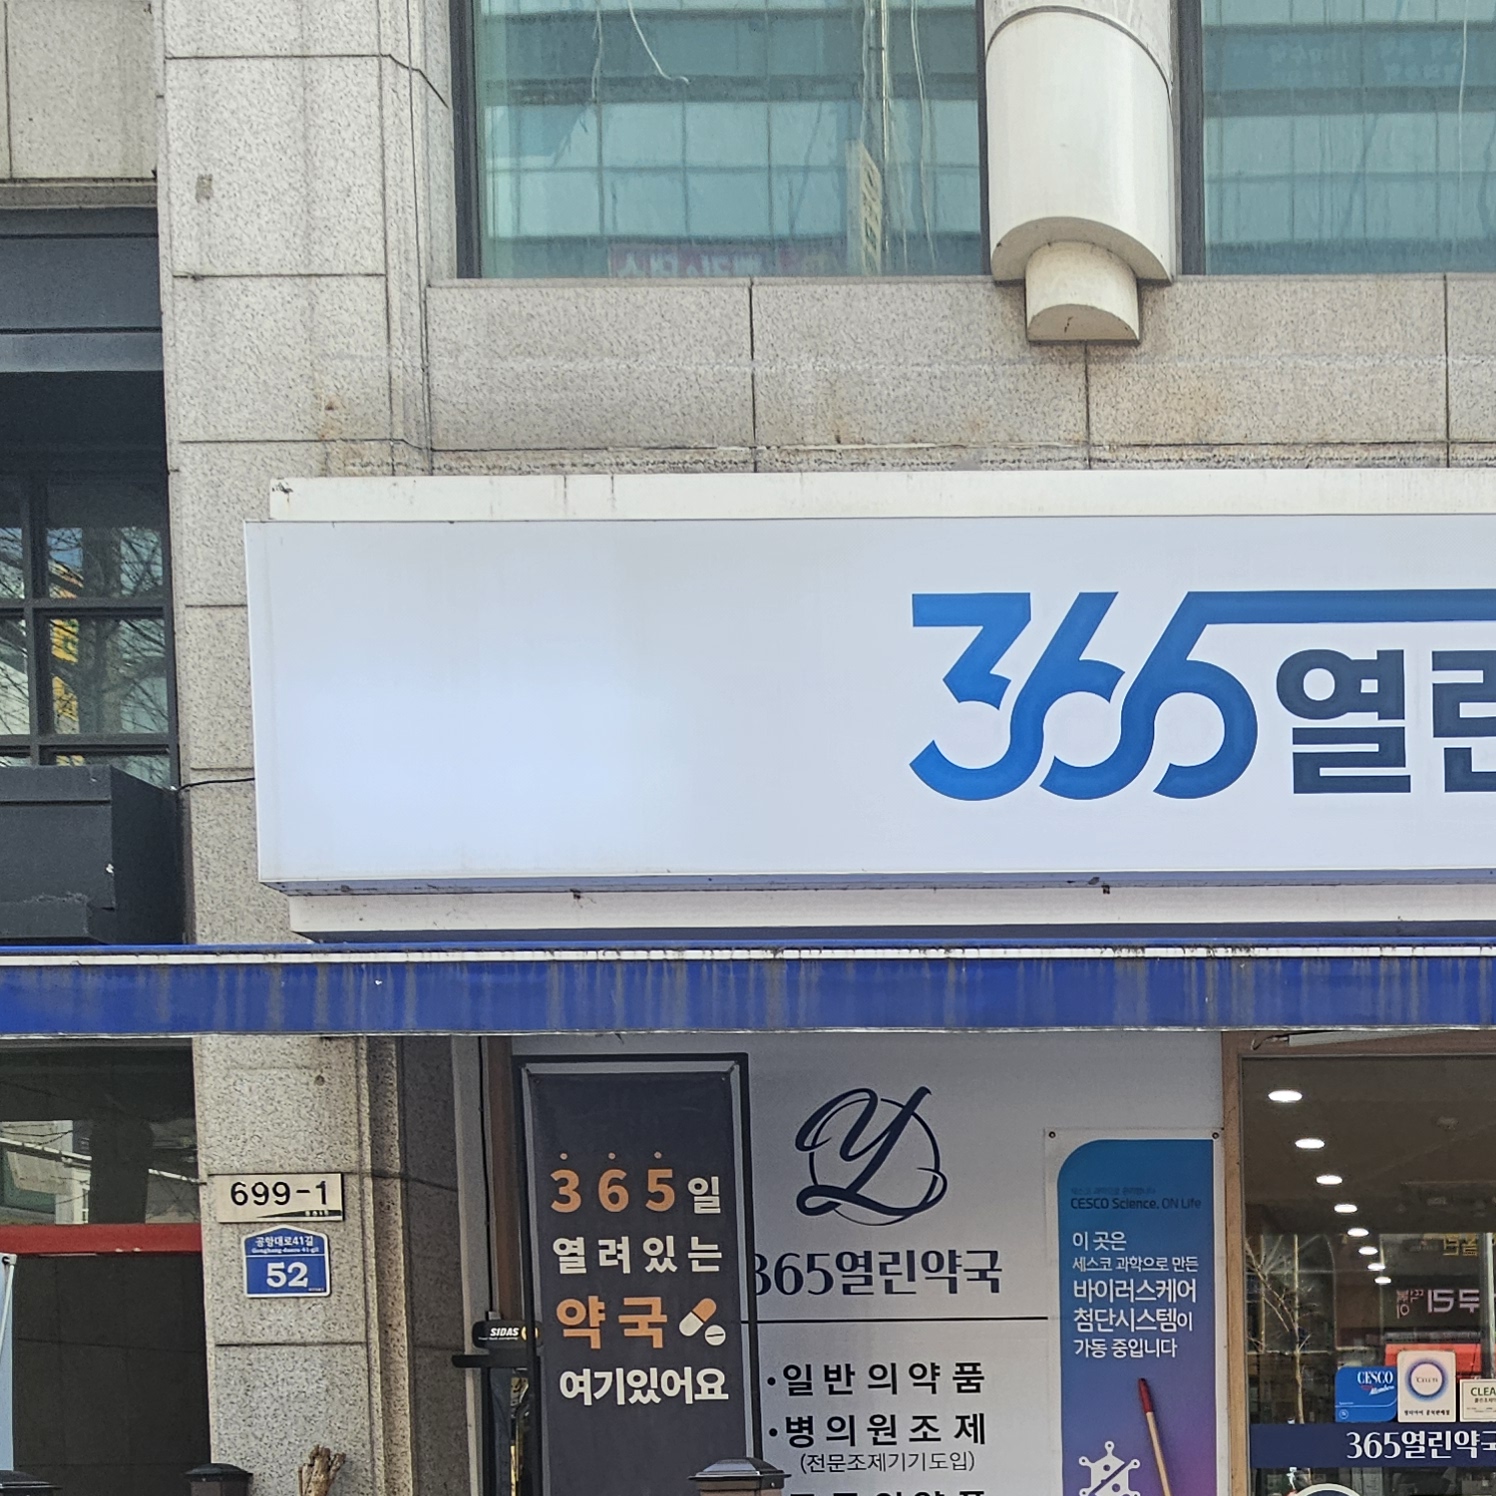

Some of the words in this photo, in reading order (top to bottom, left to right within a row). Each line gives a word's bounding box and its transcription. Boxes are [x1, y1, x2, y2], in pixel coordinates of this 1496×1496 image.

[231, 1181, 326, 1206] 699-1
[1070, 1197, 1109, 1210] CESCO
[1111, 1197, 1160, 1210] Science.
[1162, 1198, 1179, 1209] ON
[1181, 1198, 1201, 1209] Life
[255, 1236, 314, 1247] 공항대로41길
[1072, 1231, 1088, 1251] 이
[1093, 1231, 1127, 1251] 곳은
[552, 1235, 723, 1276] 열려있는
[1072, 1256, 1113, 1273] 세스코
[1115, 1256, 1169, 1273] 과학으로
[1171, 1256, 1199, 1272] 만든
[266, 1262, 308, 1287] 52
[754, 1250, 1003, 1297] 365열린약국
[1073, 1278, 1197, 1303] 바이러스케어
[490, 1327, 519, 1337] SIDAS
[556, 1296, 668, 1350] 약국
[1073, 1307, 1193, 1333] 첨단시스템이
[1073, 1338, 1108, 1358] 가동
[1111, 1338, 1178, 1358] 중입니다
[559, 1366, 729, 1405] 여기있어요
[782, 1361, 987, 1395] 일반의약품
[1357, 1370, 1393, 1384] CESCO
[784, 1413, 988, 1448] 병의원조제
[799, 1450, 976, 1475] (전문조제기기도입)
